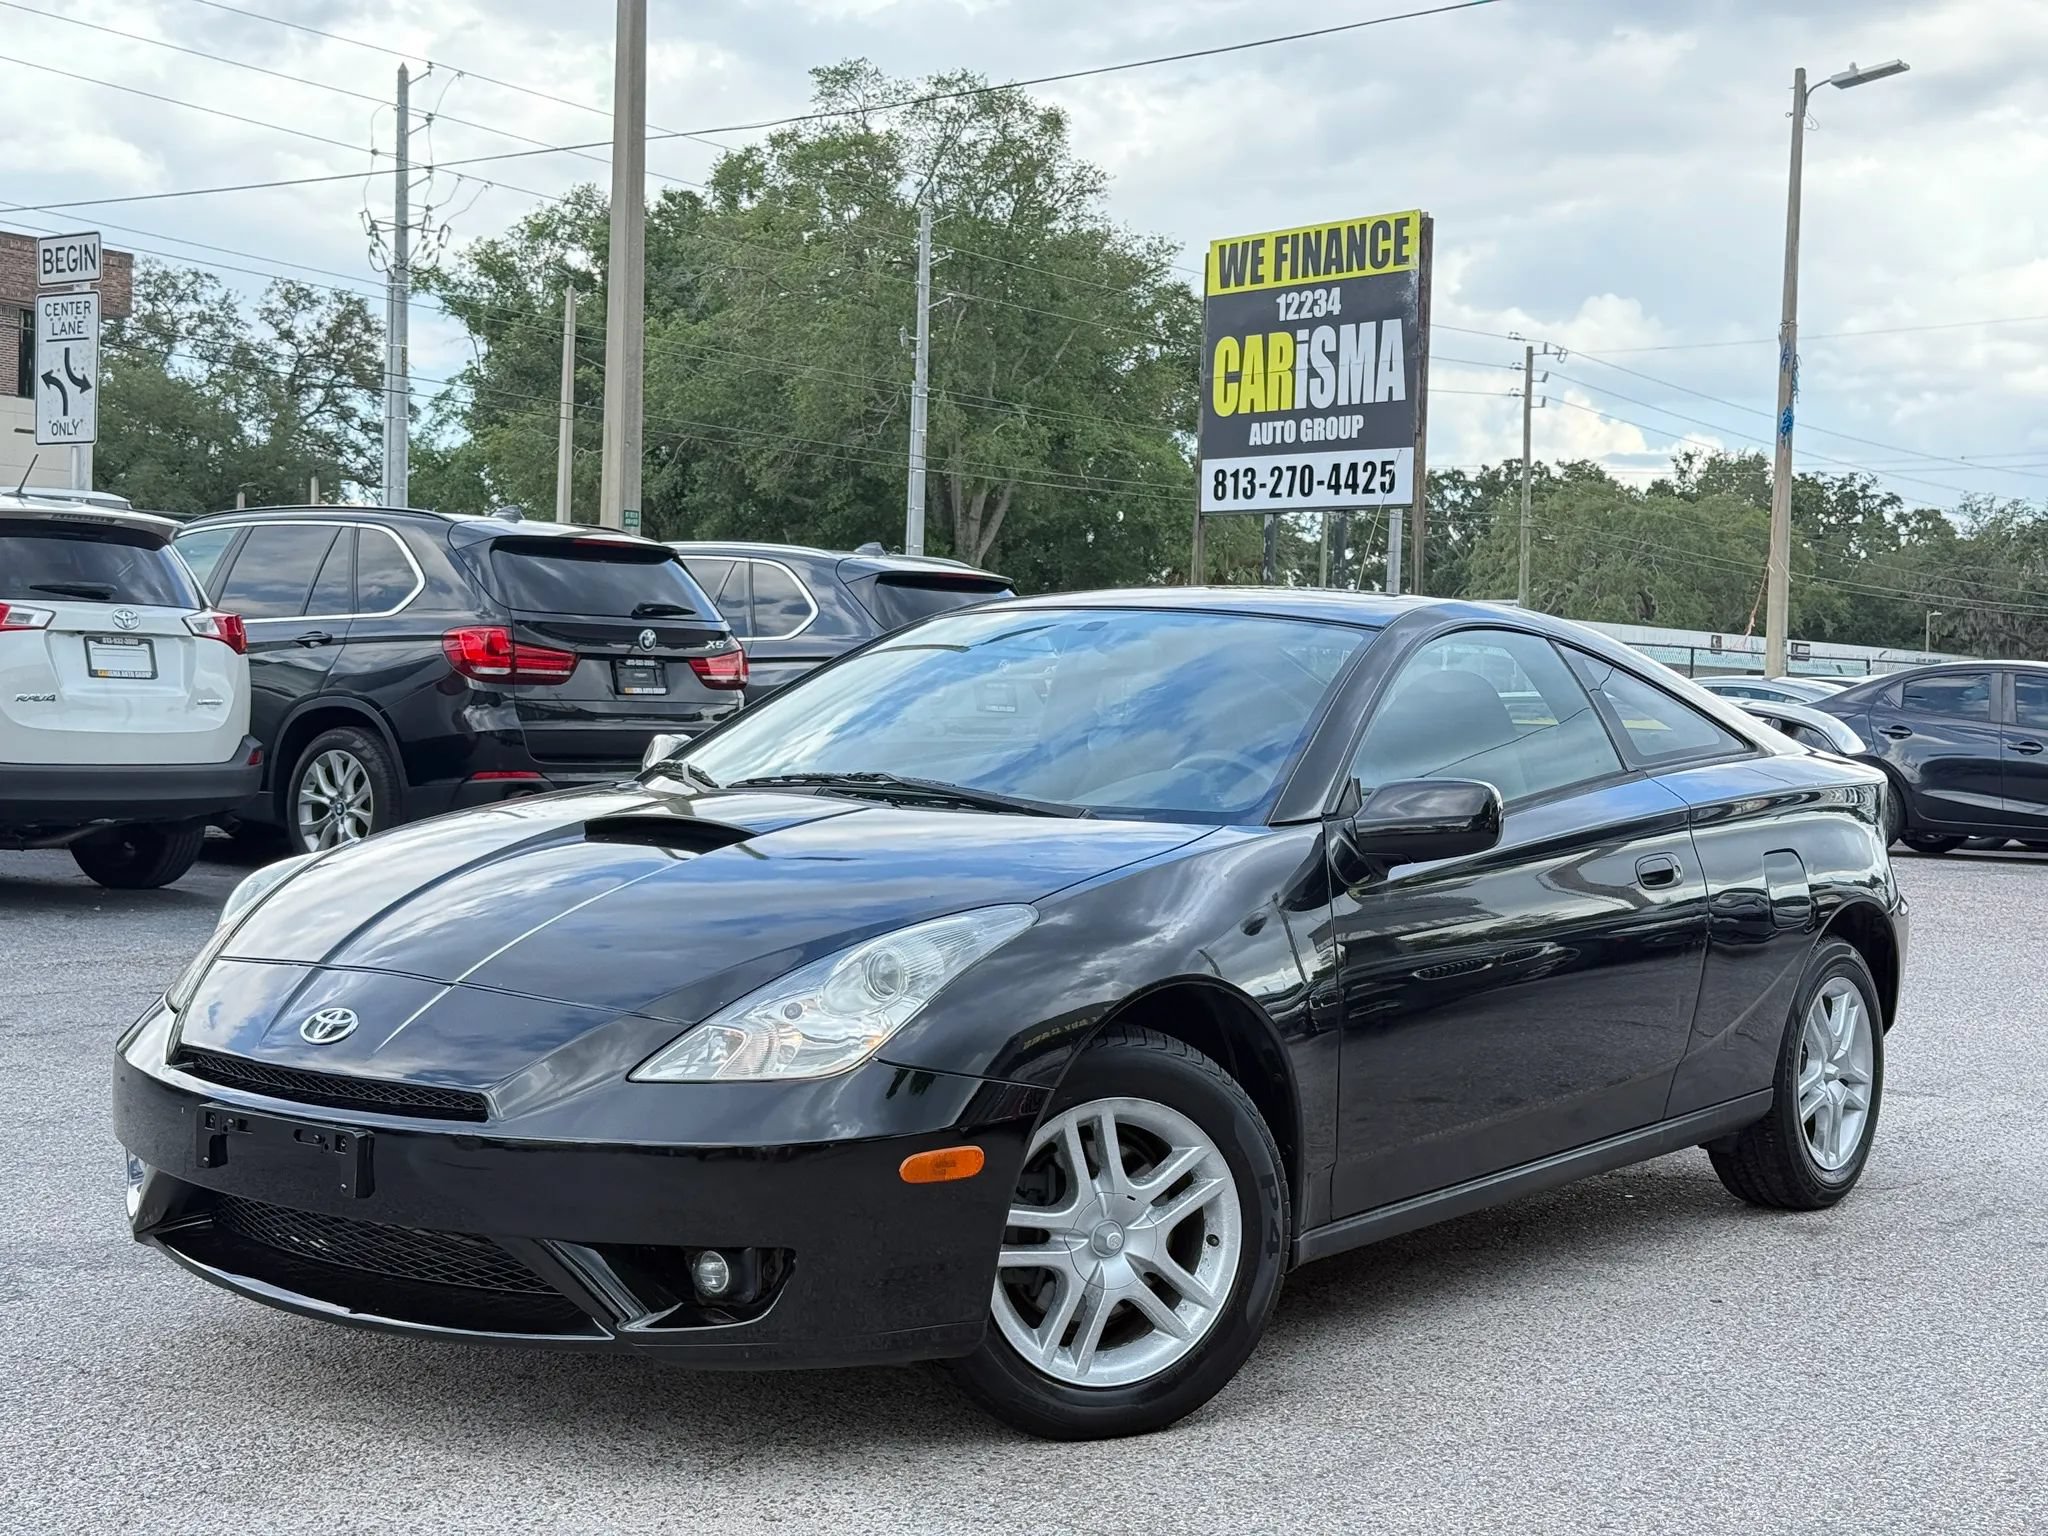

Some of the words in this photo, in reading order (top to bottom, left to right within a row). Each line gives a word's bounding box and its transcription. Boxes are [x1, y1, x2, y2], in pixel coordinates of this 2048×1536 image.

[42, 243, 96, 275] BEGIN
[1218, 238, 1265, 290] WE
[1273, 217, 1410, 282] FINANCE
[45, 301, 91, 317] CENTER
[1276, 287, 1342, 321] 12234
[52, 320, 84, 336] LANE
[51, 421, 80, 437] ONLY
[1249, 419, 1296, 446] AUTO
[1300, 414, 1364, 443] GROUP
[1213, 460, 1396, 501] 813-270-4425
